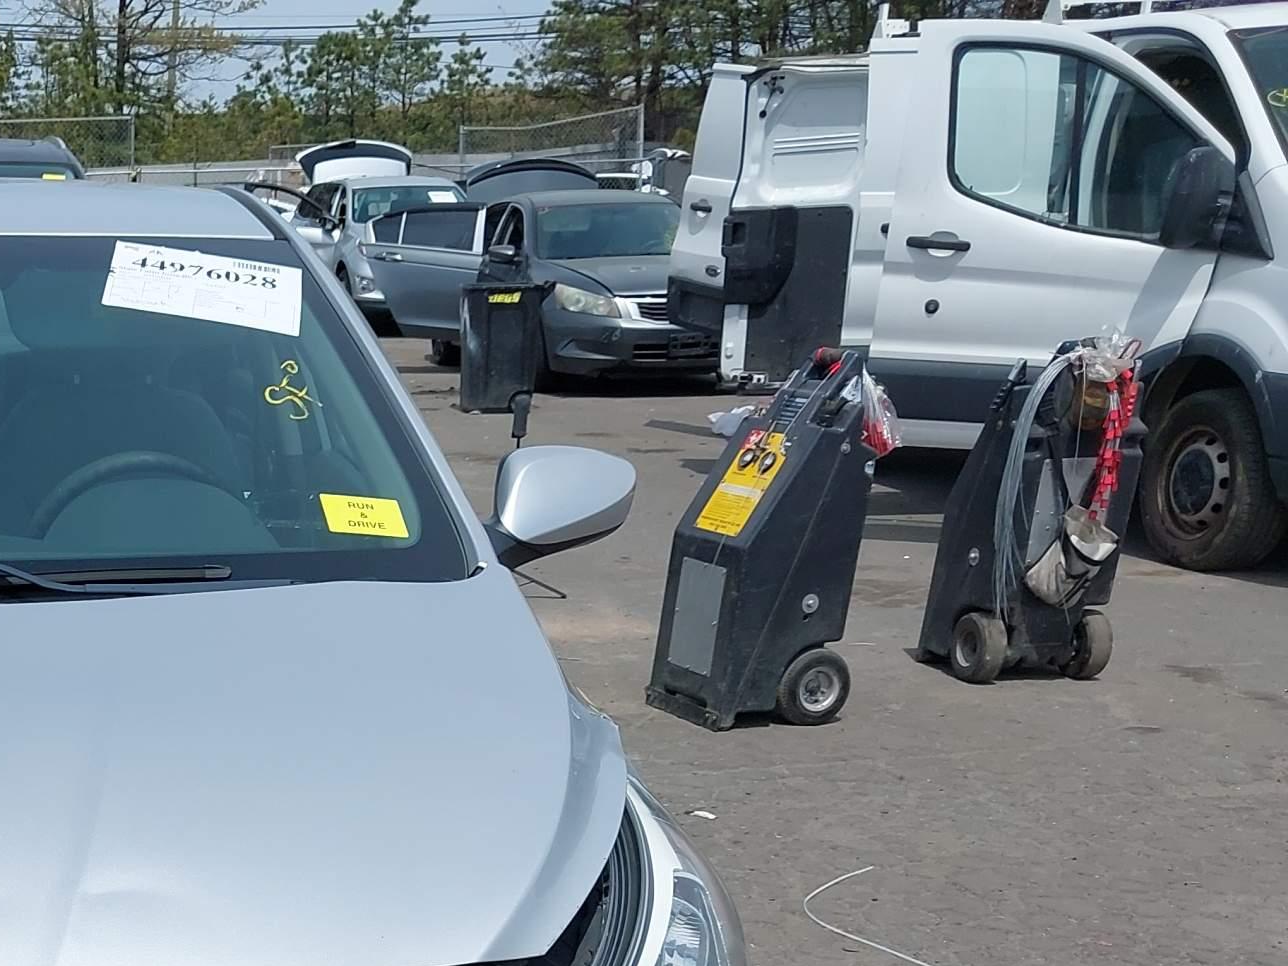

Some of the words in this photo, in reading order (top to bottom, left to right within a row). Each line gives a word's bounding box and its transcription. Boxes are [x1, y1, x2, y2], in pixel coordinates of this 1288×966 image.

[132, 256, 278, 290] 44976028
[347, 501, 375, 511] RUN
[360, 511, 368, 519] &
[348, 519, 387, 530] DRIVE
